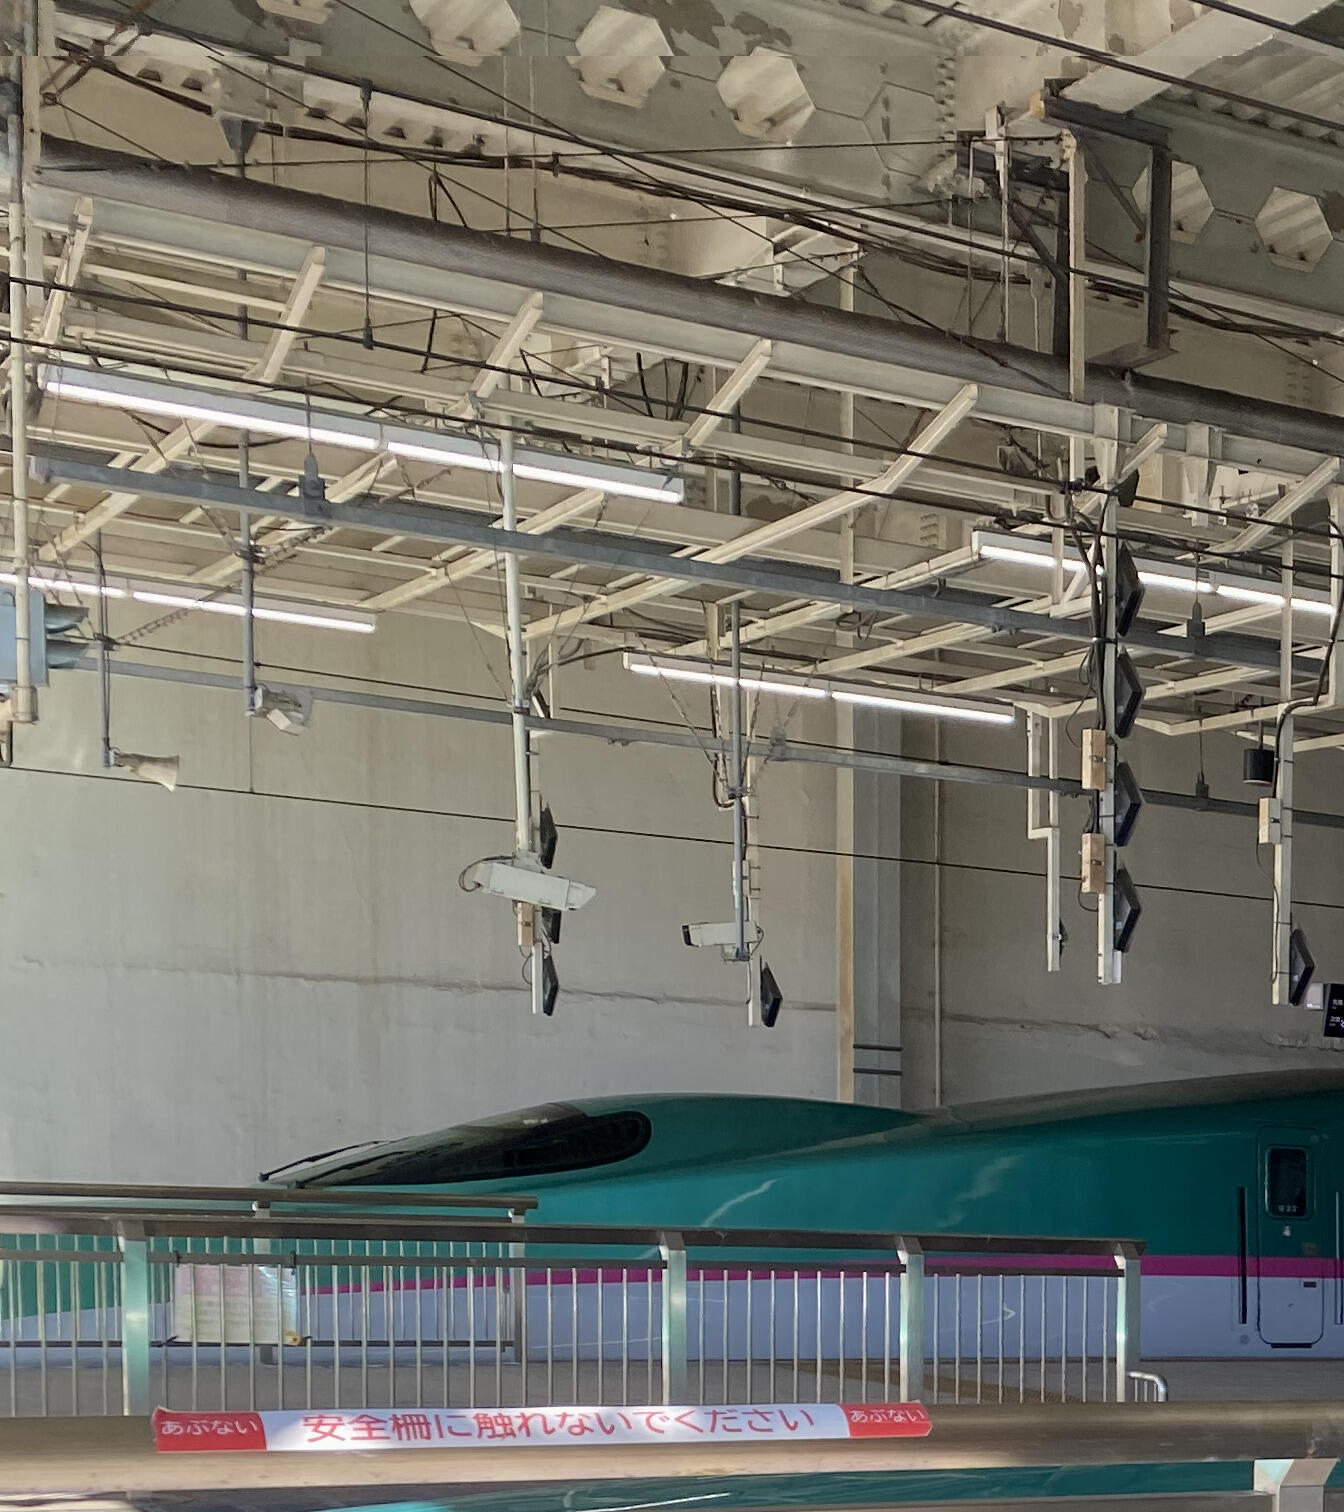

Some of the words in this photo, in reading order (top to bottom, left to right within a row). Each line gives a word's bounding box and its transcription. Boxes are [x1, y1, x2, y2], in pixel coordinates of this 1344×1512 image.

[160, 1418, 258, 1437] あぶない
[302, 1408, 815, 1443] 安全柵に触れないでください
[850, 1408, 925, 1423] あぶない
